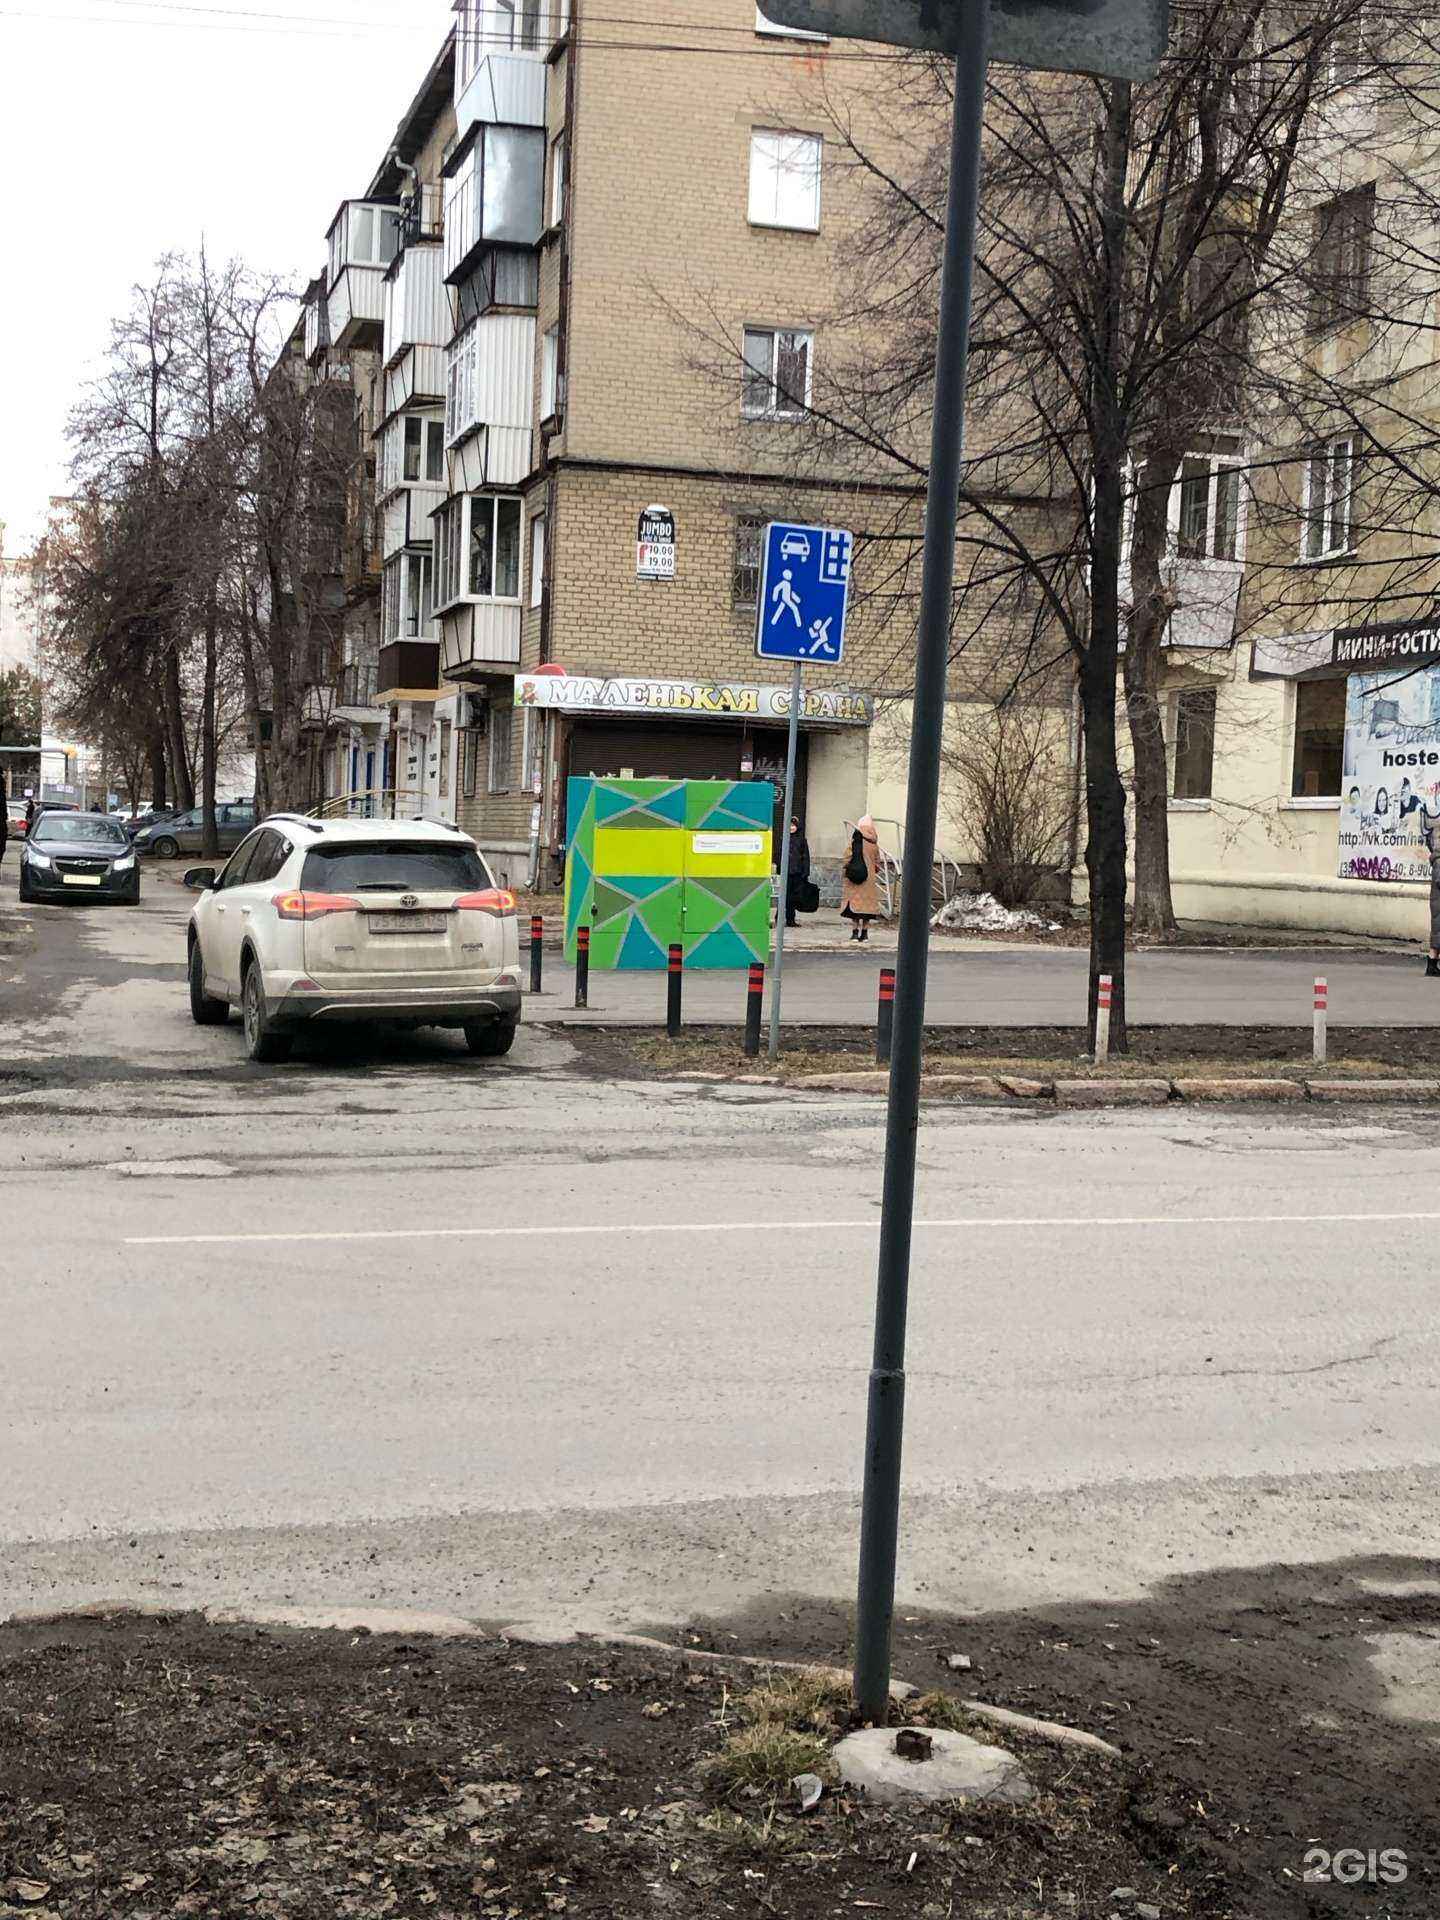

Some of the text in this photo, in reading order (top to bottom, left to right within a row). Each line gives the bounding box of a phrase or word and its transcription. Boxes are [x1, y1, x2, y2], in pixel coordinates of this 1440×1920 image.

[641, 521, 672, 537] JUMBO
[649, 557, 673, 567] 19.00
[549, 680, 760, 713] МАЛЕНЬКАЯ
